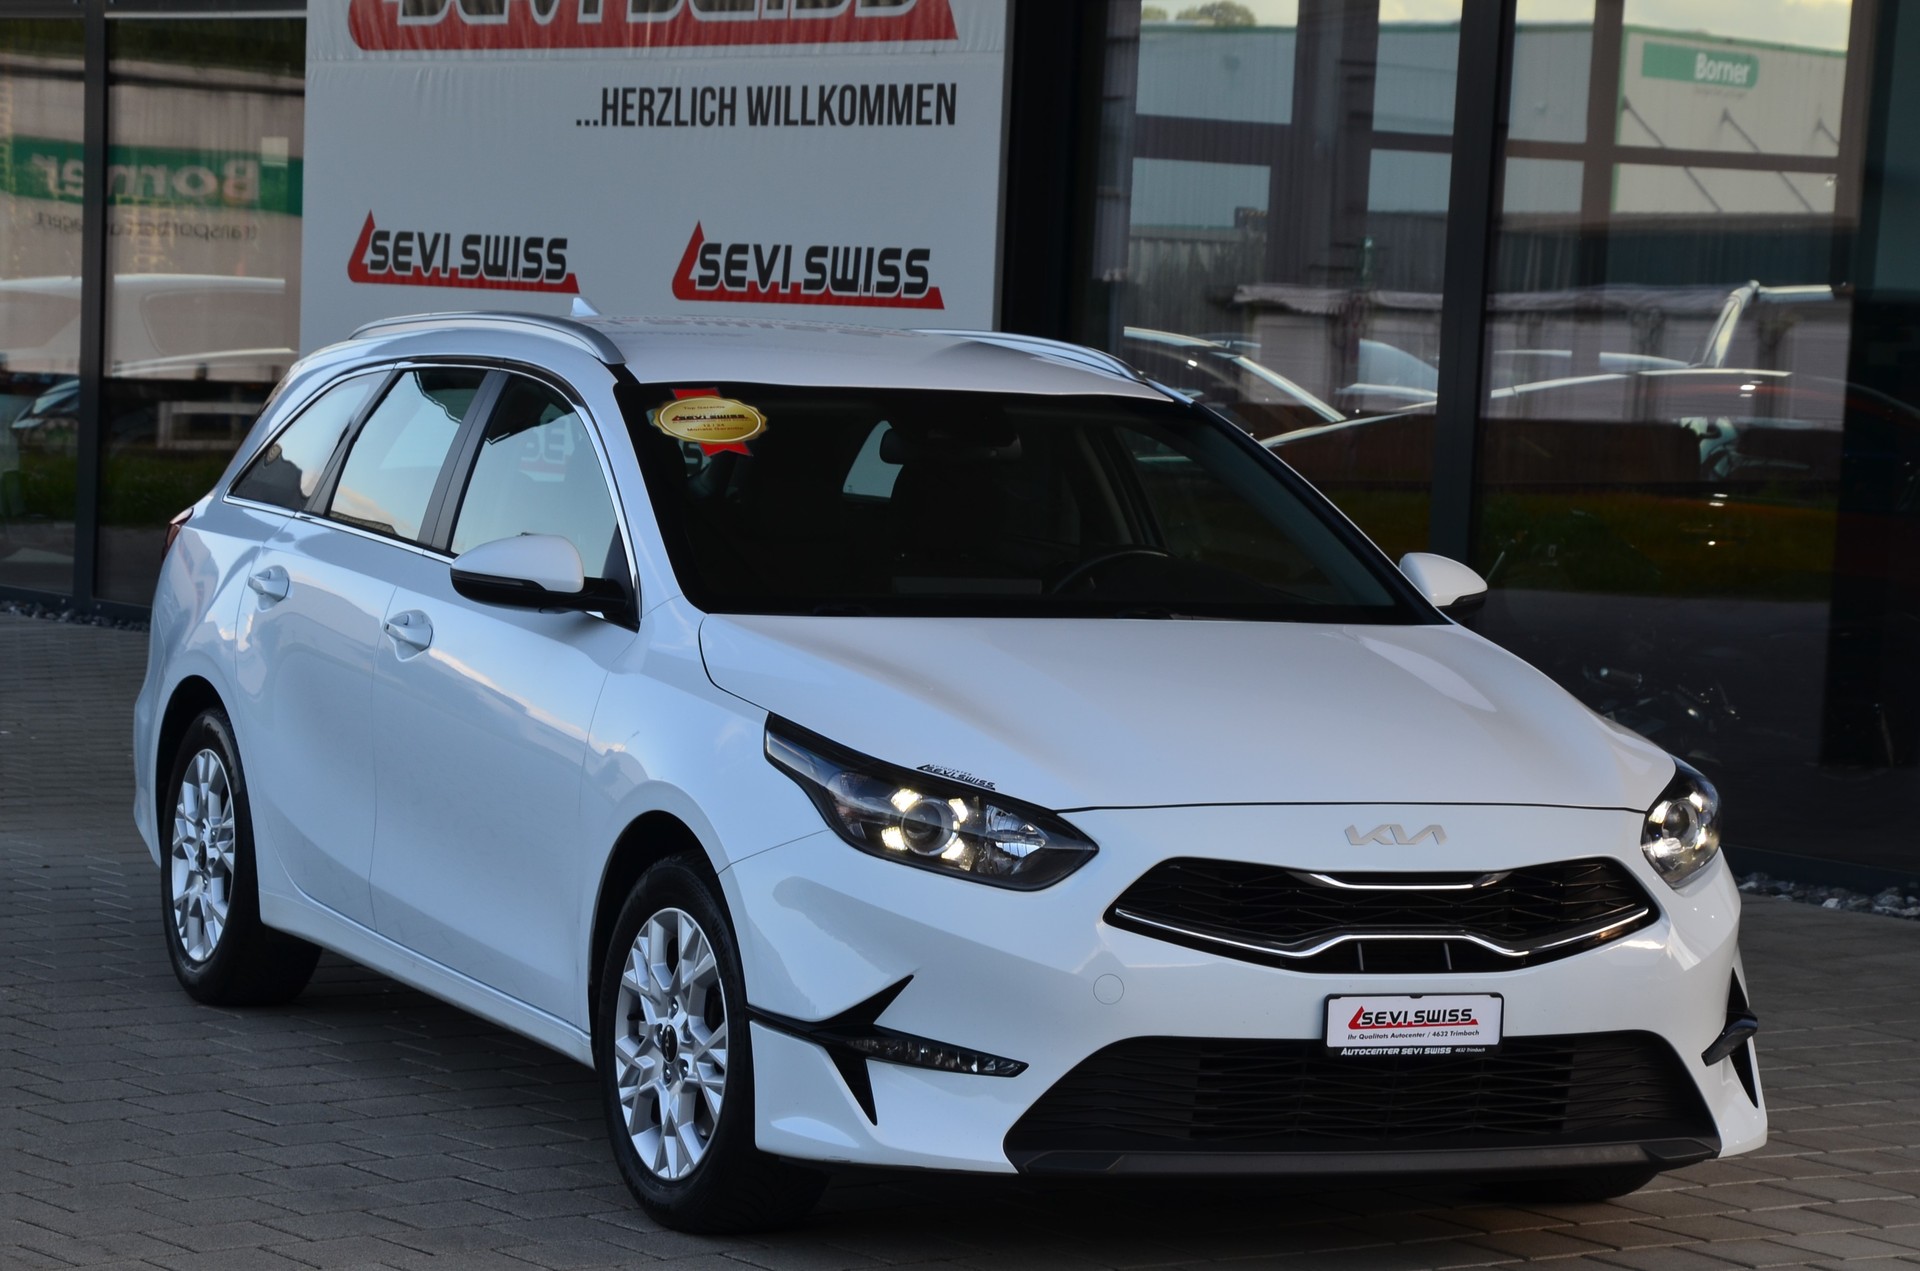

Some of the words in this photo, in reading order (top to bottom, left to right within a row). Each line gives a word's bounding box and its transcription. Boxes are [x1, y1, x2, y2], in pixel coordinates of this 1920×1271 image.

[1694, 52, 1751, 85] Borner
[575, 86, 737, 127] ...HERZLICH
[746, 83, 957, 126] WILLKOMMEN
[368, 230, 451, 276] SEVI
[459, 234, 568, 281] SWISS
[697, 243, 793, 291] SEVI
[803, 246, 931, 296] SWISS
[1344, 824, 1448, 845] KIA
[1361, 1010, 1409, 1025] SEVI
[1413, 1008, 1473, 1024] SWISS
[1450, 1029, 1480, 1037] Trimbach
[1401, 1047, 1423, 1055] SEVI
[1424, 1046, 1453, 1055] SWISS
